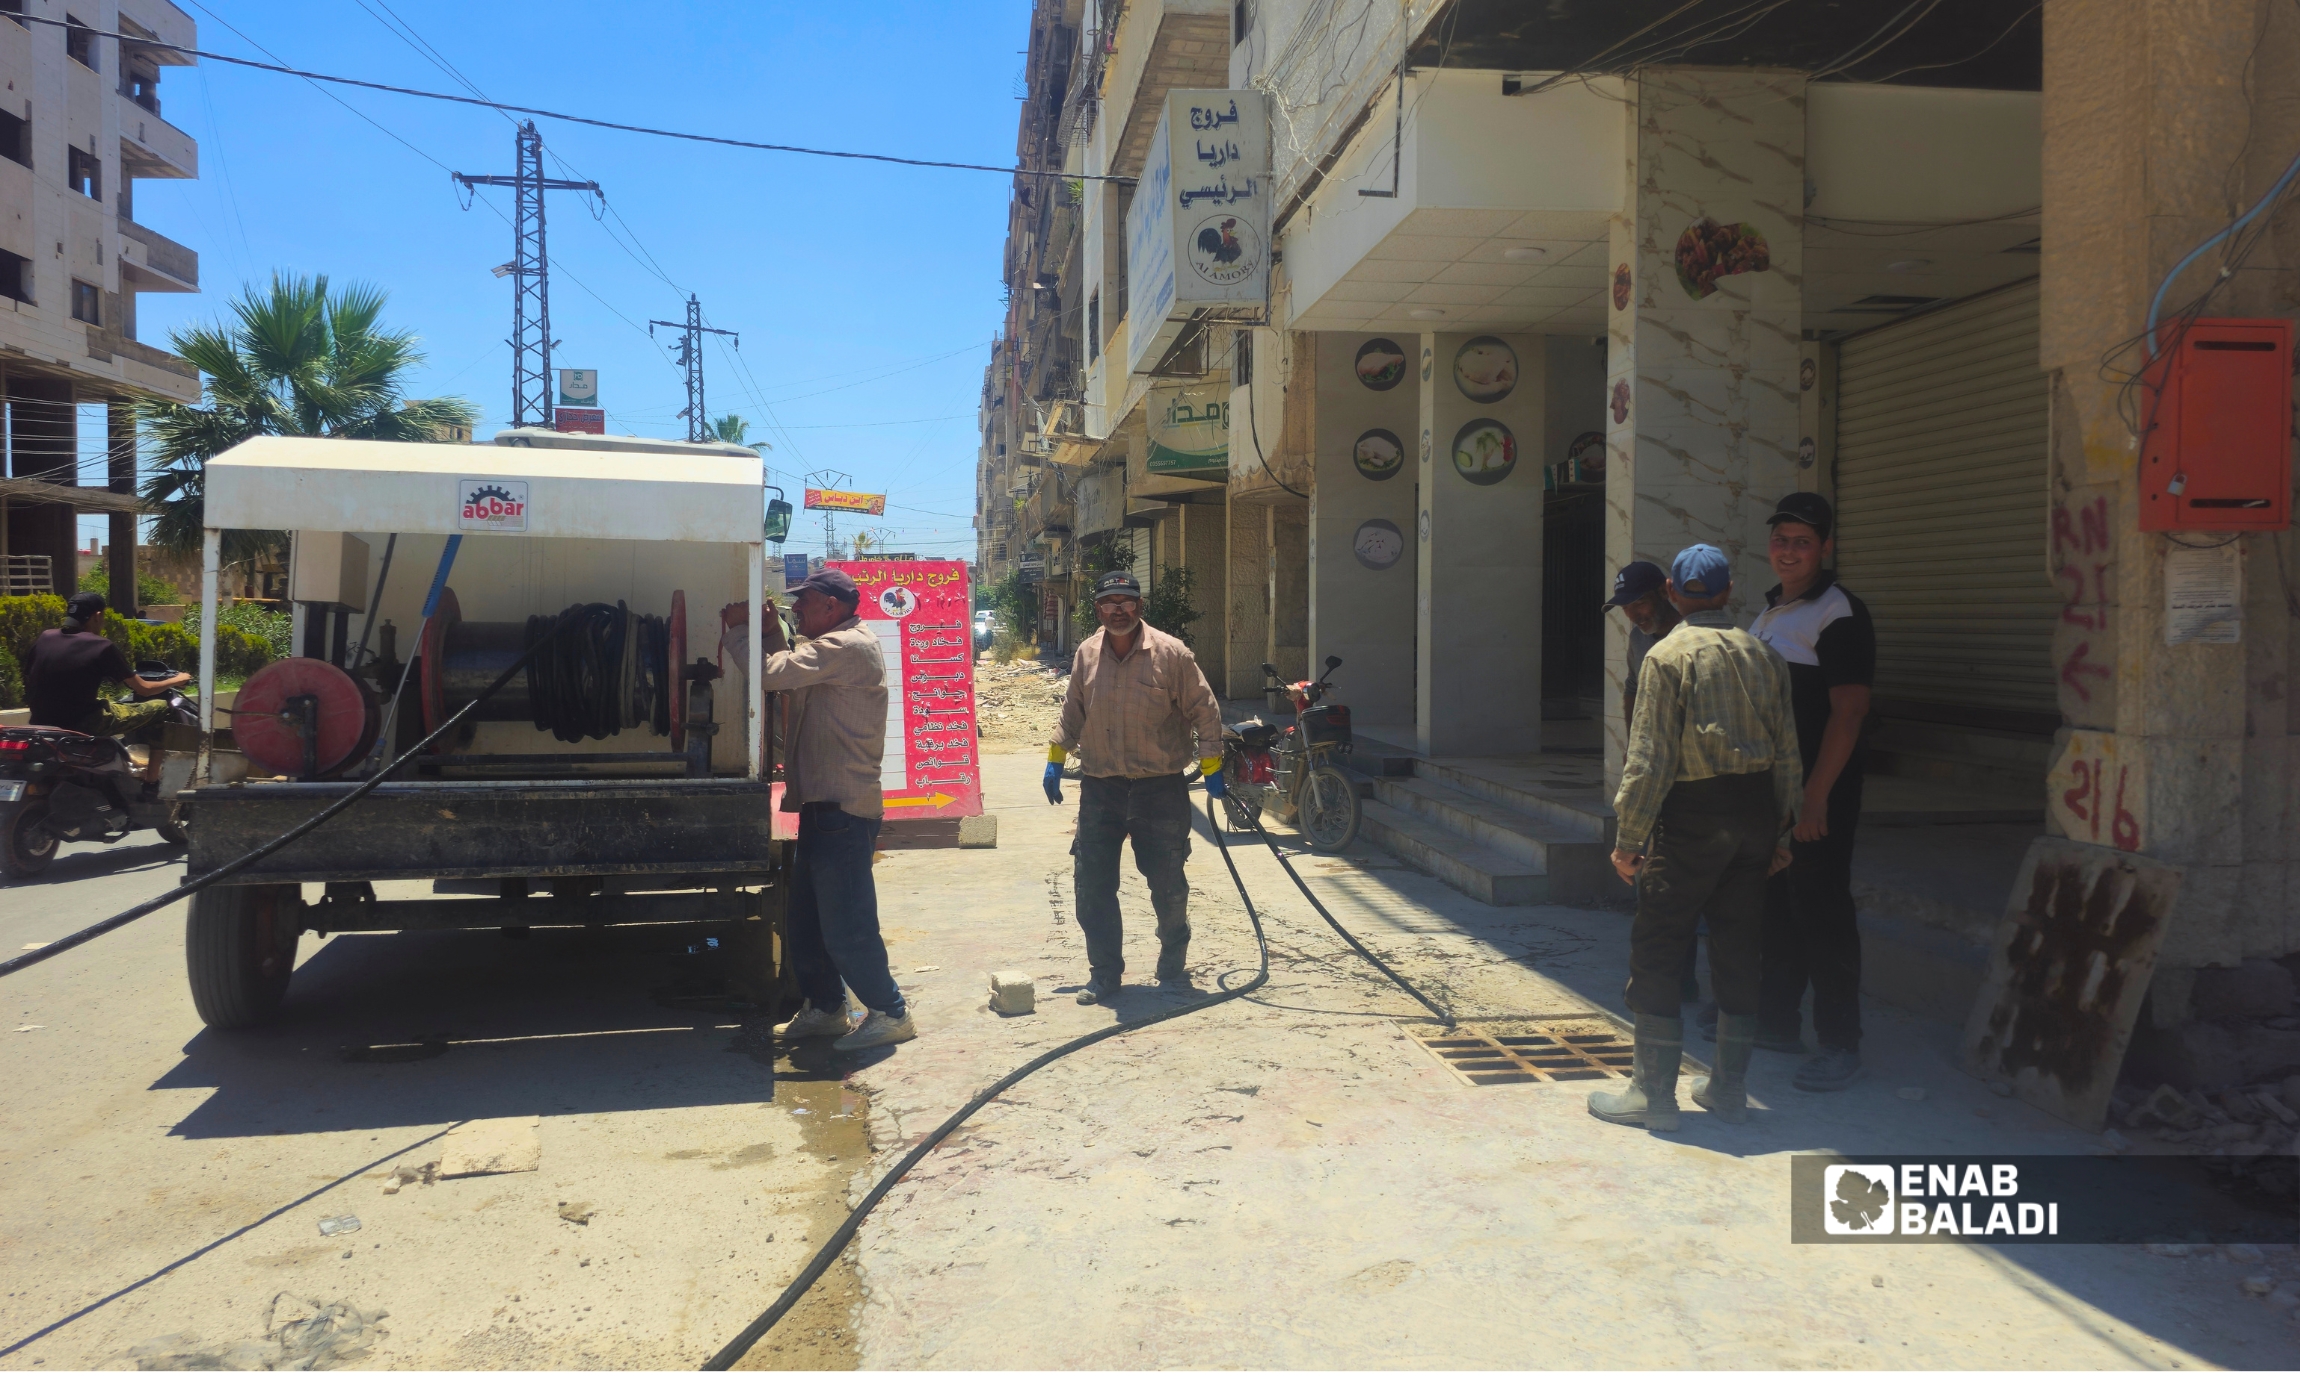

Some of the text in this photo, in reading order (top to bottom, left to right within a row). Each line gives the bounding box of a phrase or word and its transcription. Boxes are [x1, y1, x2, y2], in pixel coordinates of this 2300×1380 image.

[1190, 99, 1239, 131] فروج
[1196, 138, 1241, 168] داريا
[1179, 175, 1259, 210] الرئيسي
[463, 497, 525, 520] abbar
[893, 569, 924, 586] داريا
[927, 567, 960, 587] فروج
[909, 619, 962, 633] فروج
[911, 672, 965, 684] دبوس
[914, 722, 943, 736] نظامي
[916, 755, 970, 770] قوانص
[916, 773, 972, 788] رقاب
